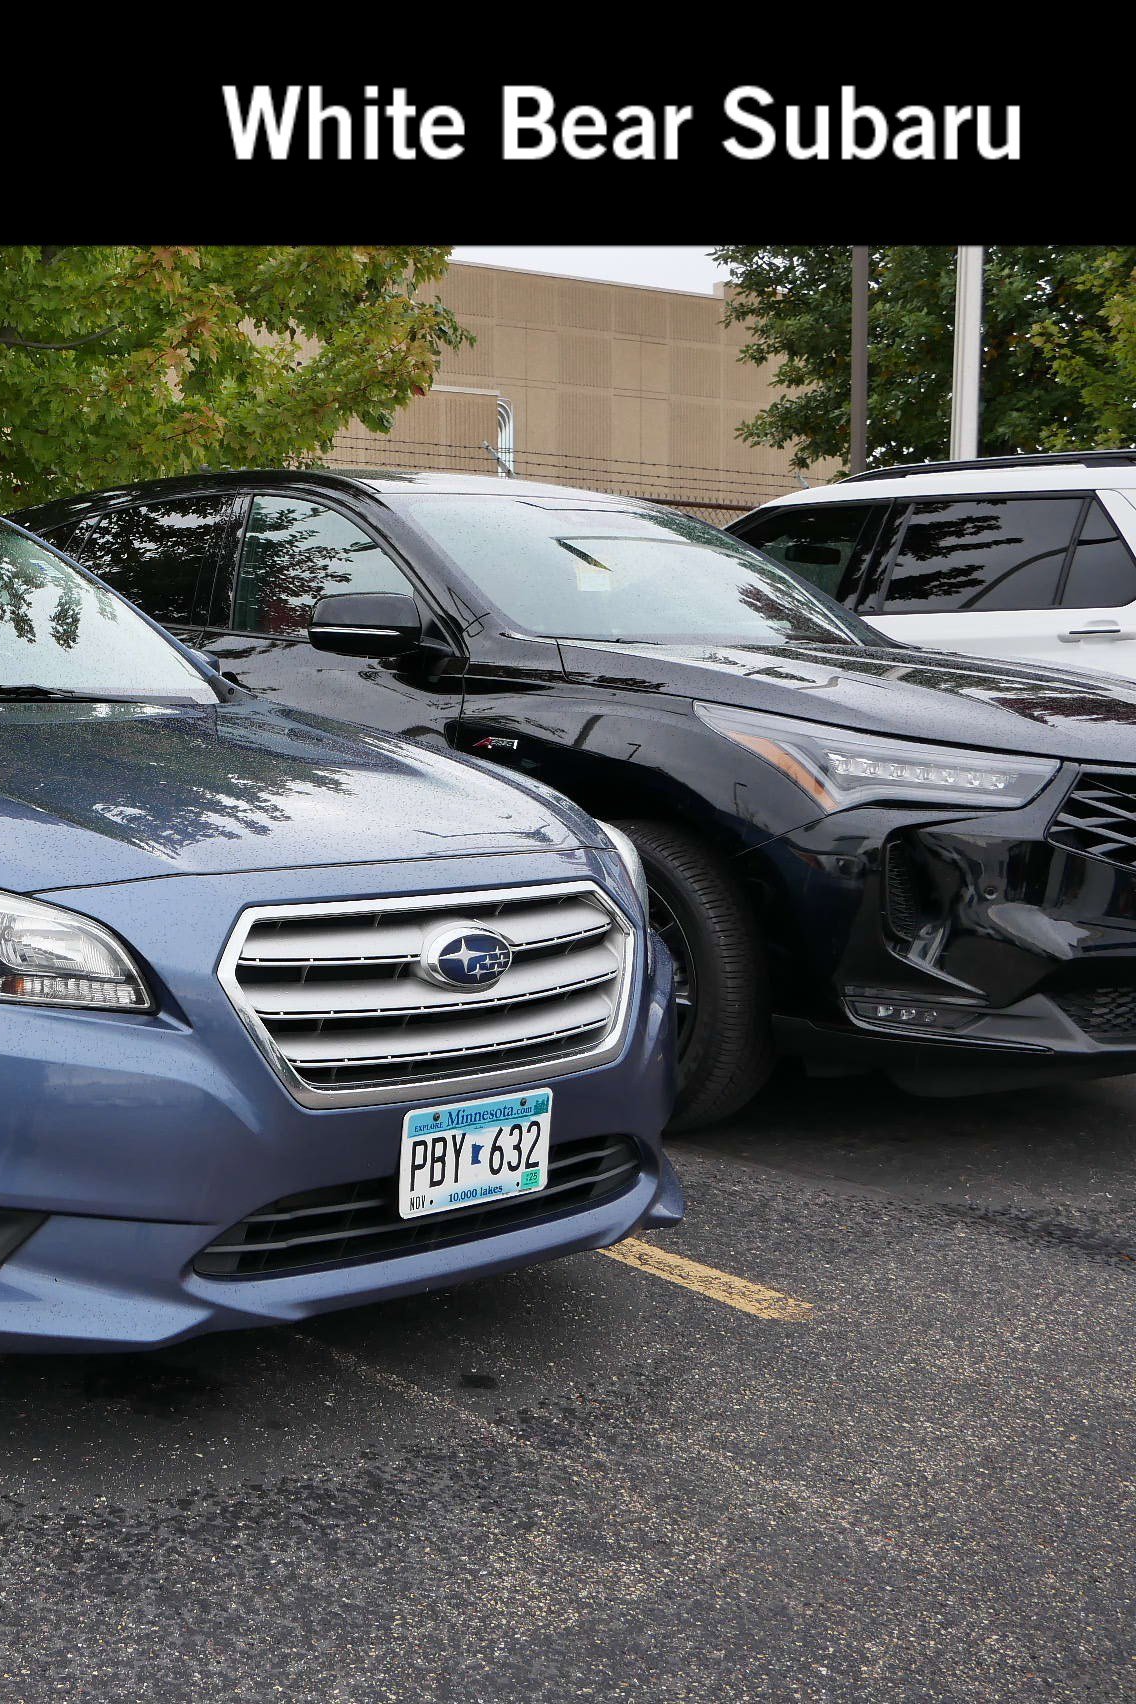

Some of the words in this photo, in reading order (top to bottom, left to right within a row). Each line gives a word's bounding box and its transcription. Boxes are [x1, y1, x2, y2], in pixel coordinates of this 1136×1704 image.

[414, 1121, 444, 1132] EXPLORE
[410, 1133, 467, 1192] PBY
[489, 1121, 541, 1175] 632
[529, 1172, 538, 1182] 25
[448, 1188, 478, 1202] 10,000
[480, 1184, 503, 1196] lakes
[409, 1195, 426, 1211] NOV
